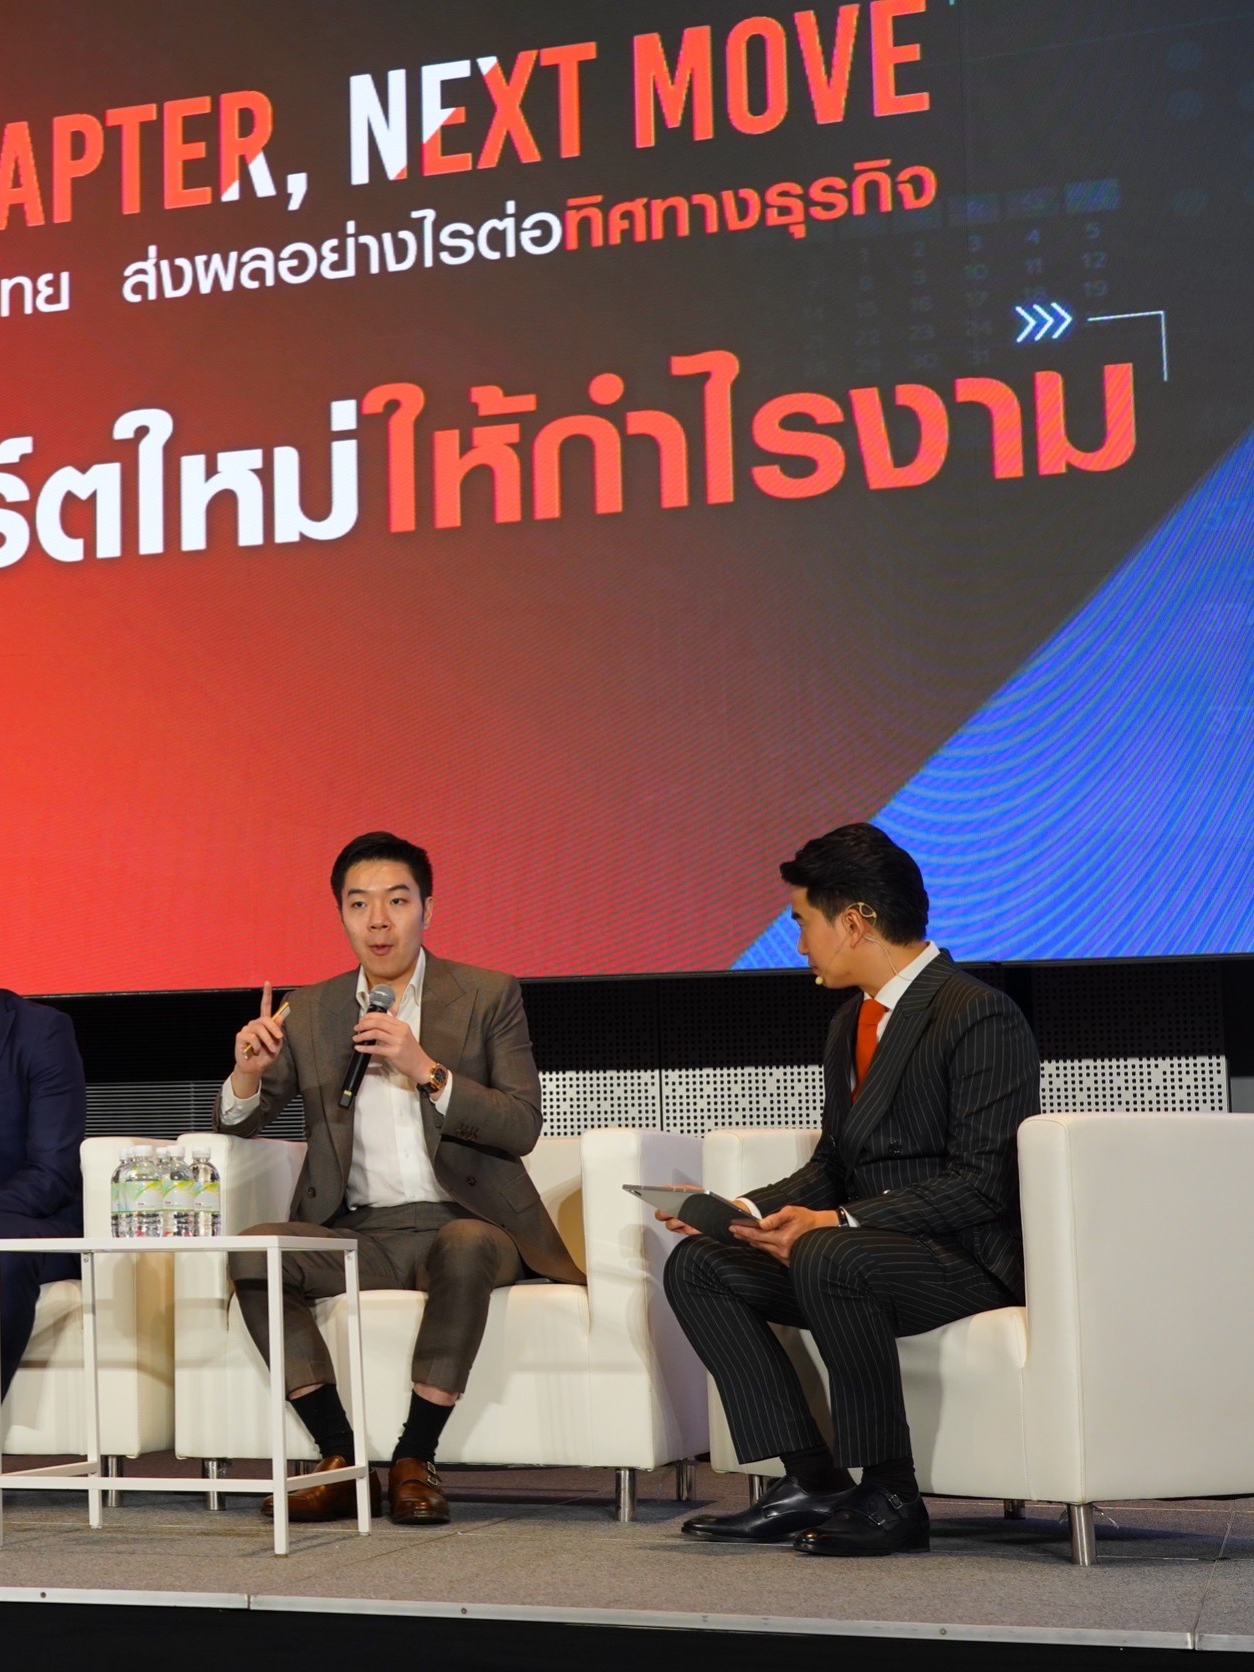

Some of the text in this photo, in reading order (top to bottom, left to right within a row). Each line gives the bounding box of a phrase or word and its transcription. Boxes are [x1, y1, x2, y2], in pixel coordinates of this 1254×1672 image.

[348, 41, 598, 187] NEXT
[632, 0, 931, 150] MOVE
[121, 158, 938, 304] ส่งผลอย่างไรต่อทิศทางธุรกิจ
[1026, 228, 1042, 246] 4
[1082, 251, 1108, 270] 12
